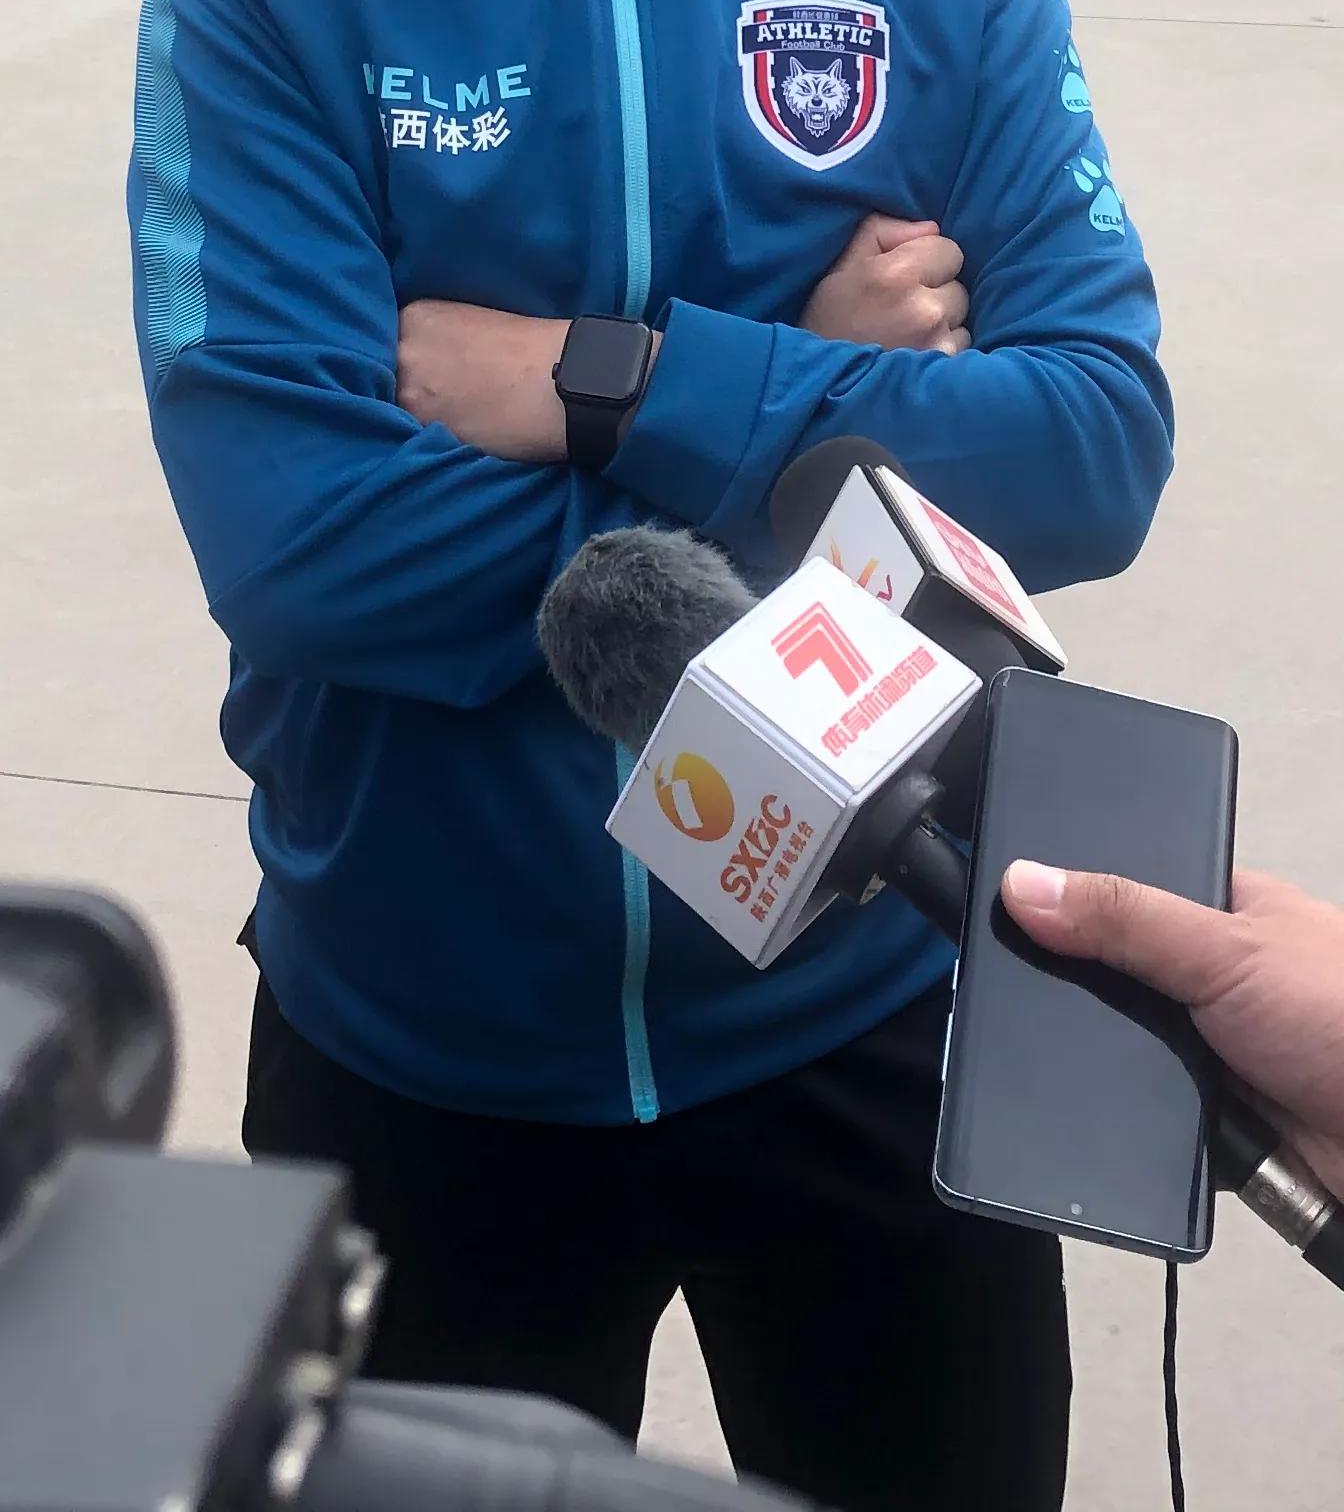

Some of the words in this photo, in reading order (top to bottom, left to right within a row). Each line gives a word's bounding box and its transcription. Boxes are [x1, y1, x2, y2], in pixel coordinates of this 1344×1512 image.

[756, 22, 873, 47] ATHLETIC
[781, 39, 821, 49] Football
[823, 40, 846, 51] Club
[378, 105, 512, 156] 西体彩
[820, 645, 938, 758] 体育休闲频道
[750, 821, 815, 923] 陕西广播电视台
